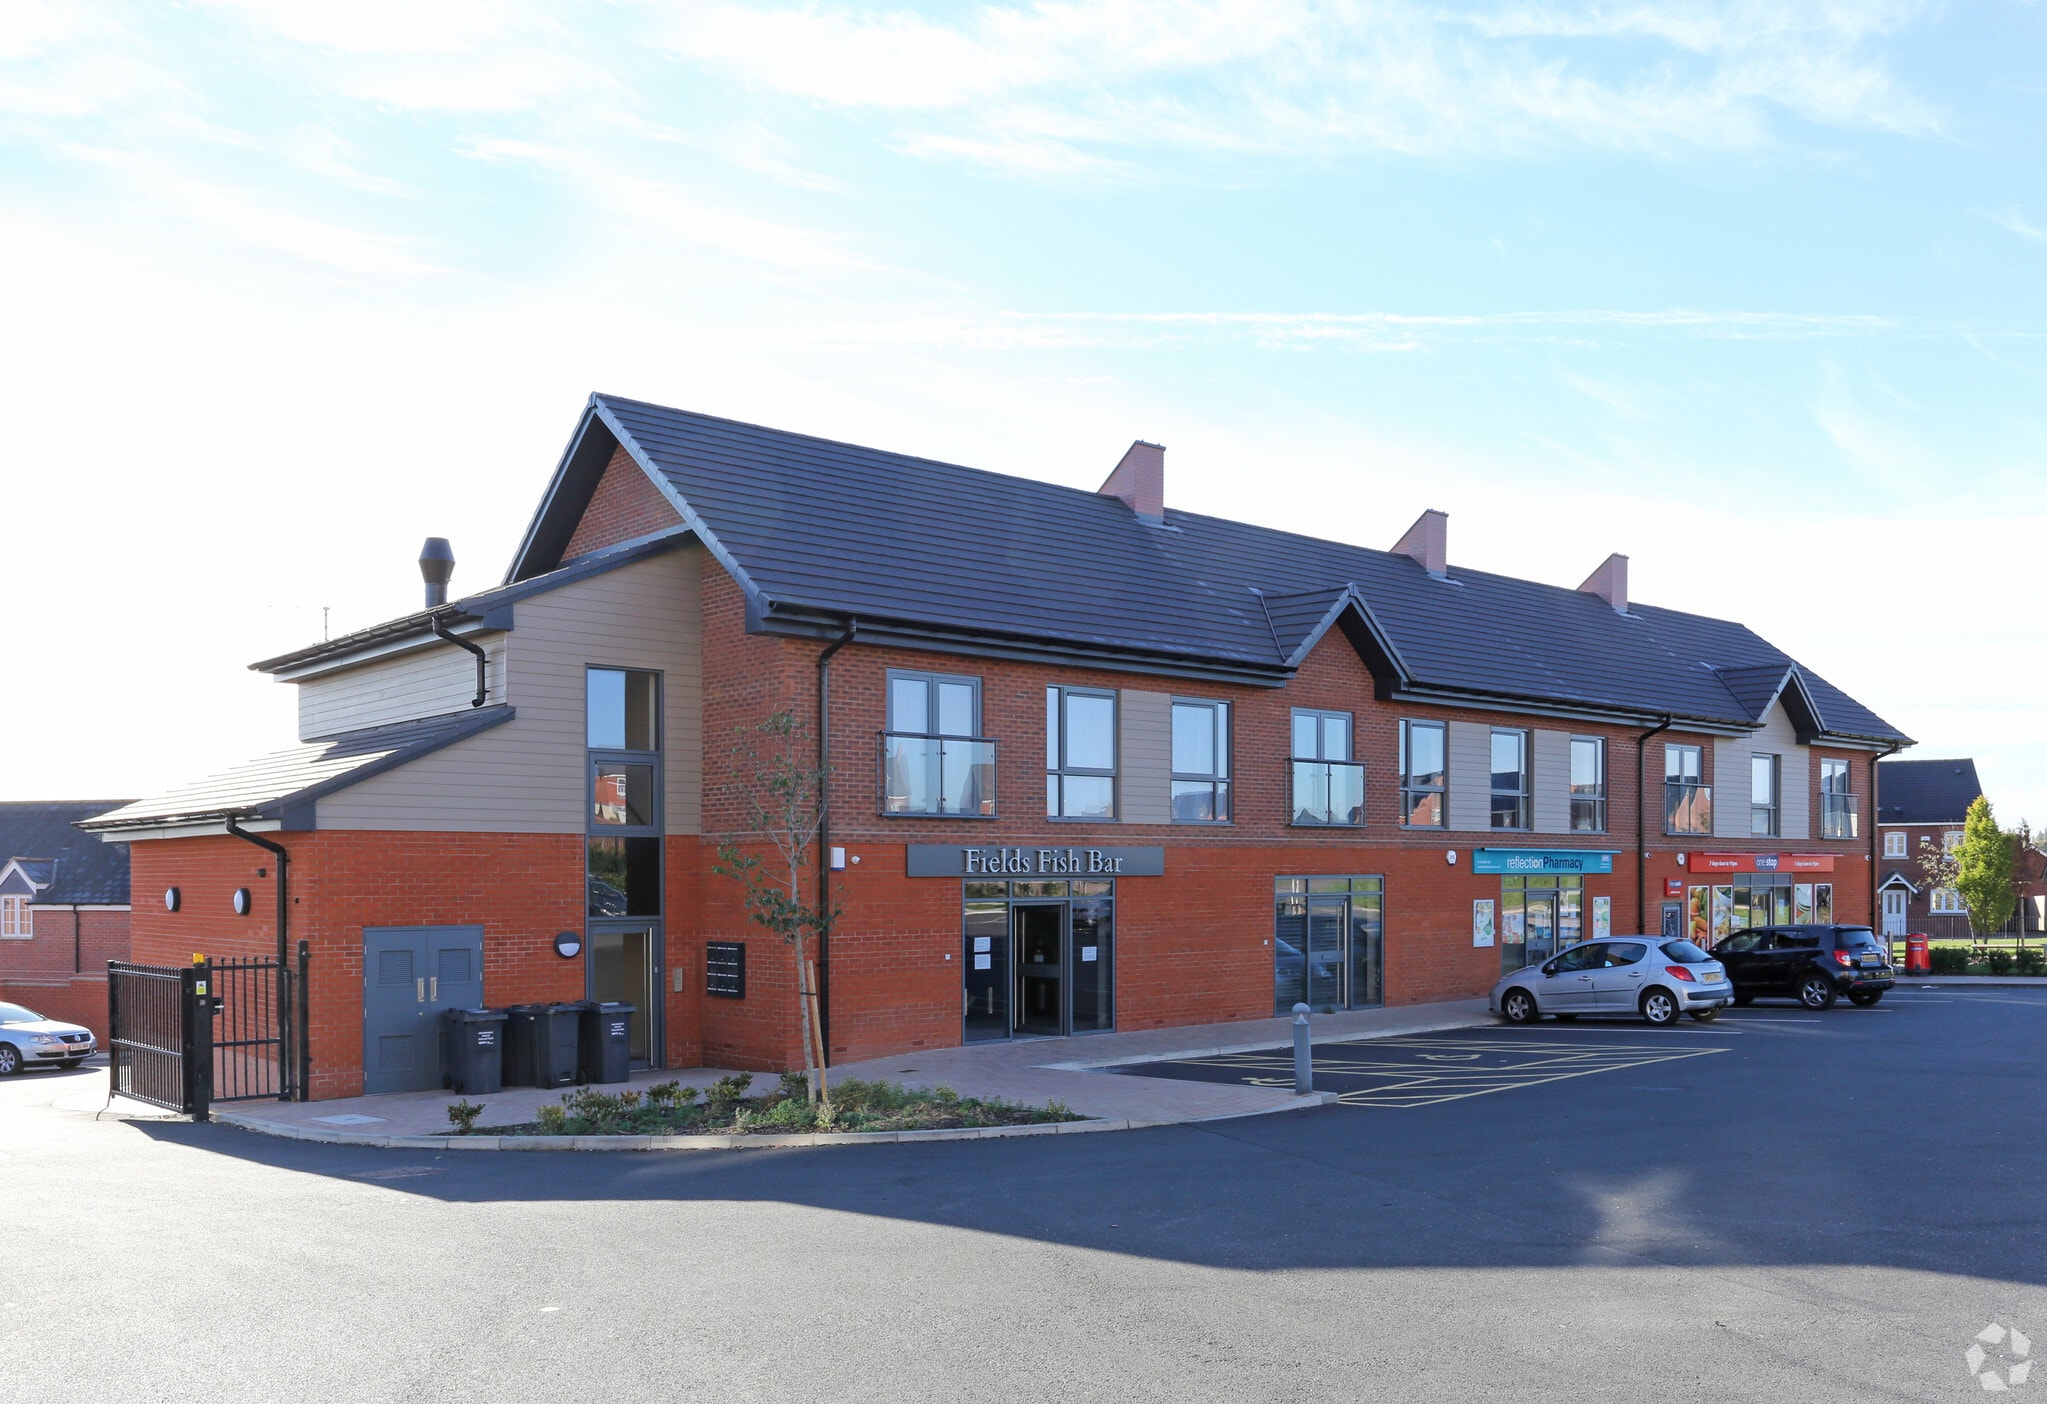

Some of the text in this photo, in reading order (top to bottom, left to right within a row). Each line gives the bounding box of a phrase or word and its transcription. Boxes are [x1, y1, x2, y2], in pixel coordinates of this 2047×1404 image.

[964, 848, 1123, 873] Fields Fish Bar
[1507, 855, 1584, 872] reflectionPharmacy
[1756, 857, 1778, 869] one stop
